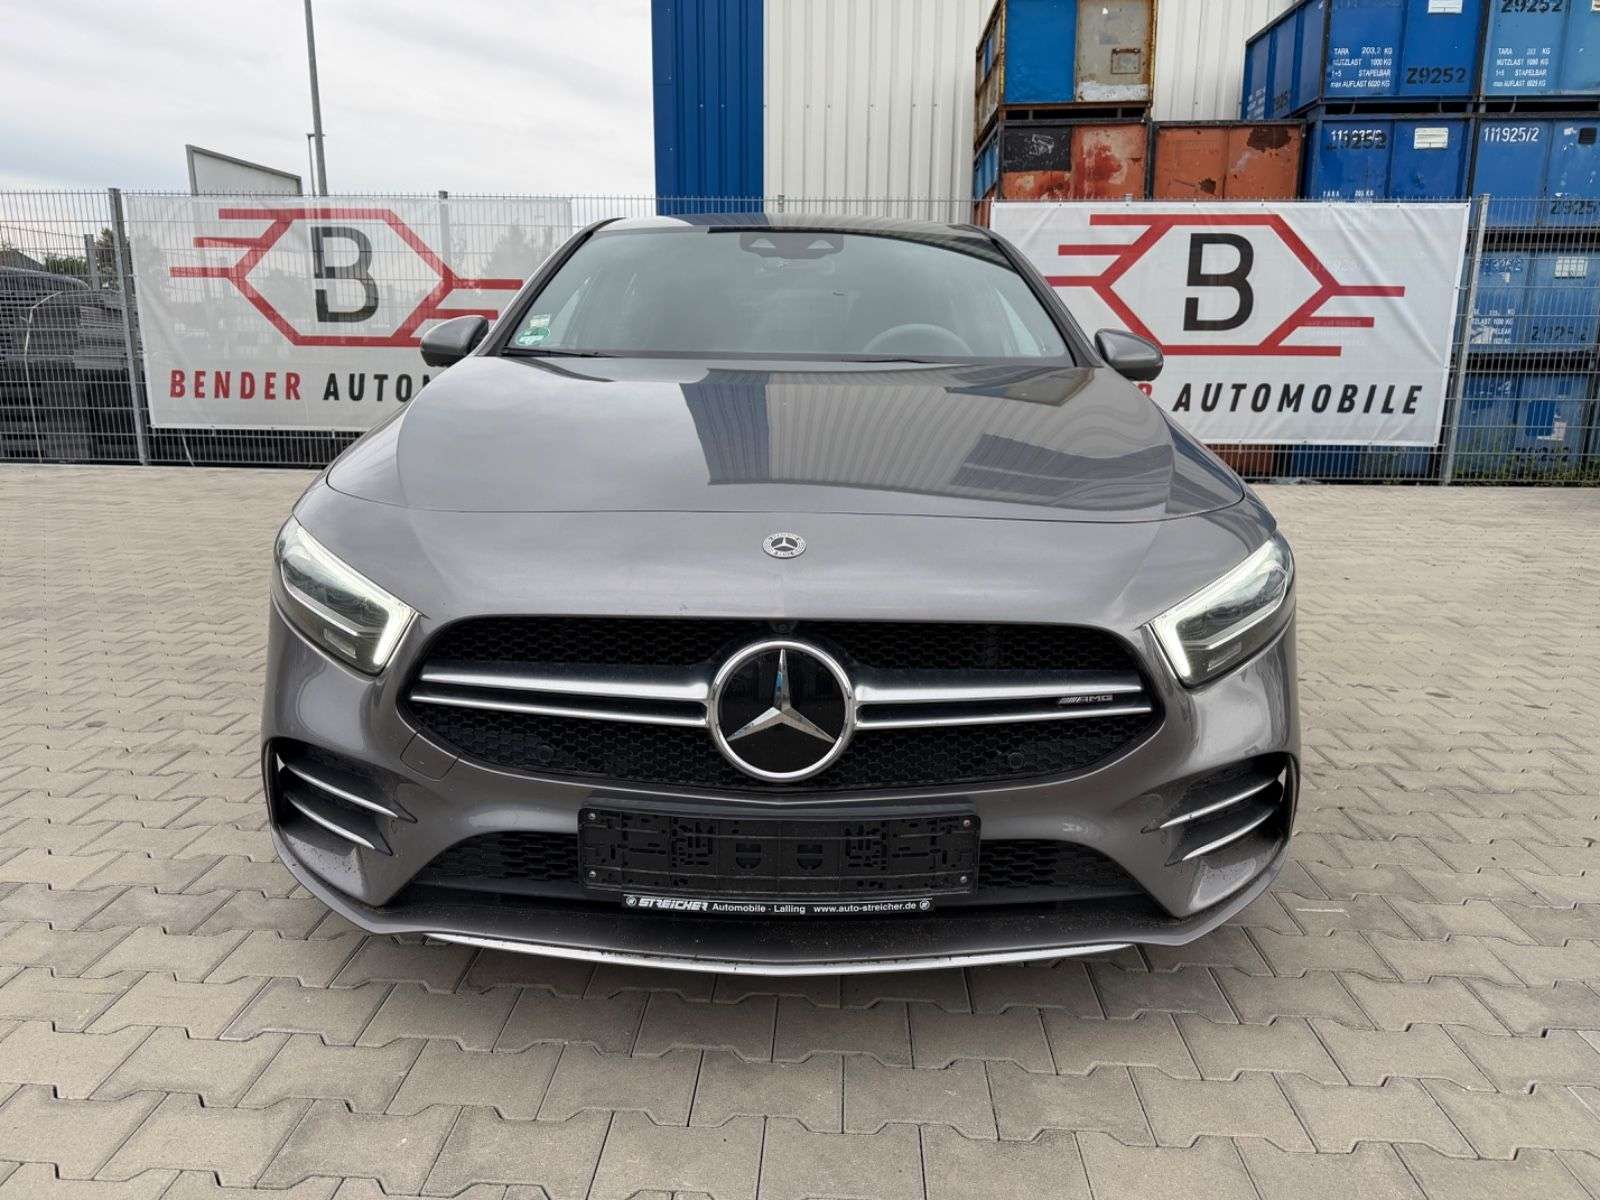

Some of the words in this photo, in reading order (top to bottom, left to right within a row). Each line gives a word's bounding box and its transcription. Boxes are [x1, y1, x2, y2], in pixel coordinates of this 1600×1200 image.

[1407, 67, 1466, 84] Z9252
[1484, 127, 1539, 142] 111925/2
[311, 226, 379, 323] B
[1183, 233, 1254, 331] B
[170, 370, 301, 400] BENDER
[1173, 383, 1422, 414] AUTOMOBILE
[638, 897, 709, 912] STREICHER
[712, 903, 766, 913] Automobile
[813, 902, 917, 913] www.auto-streicher.de
